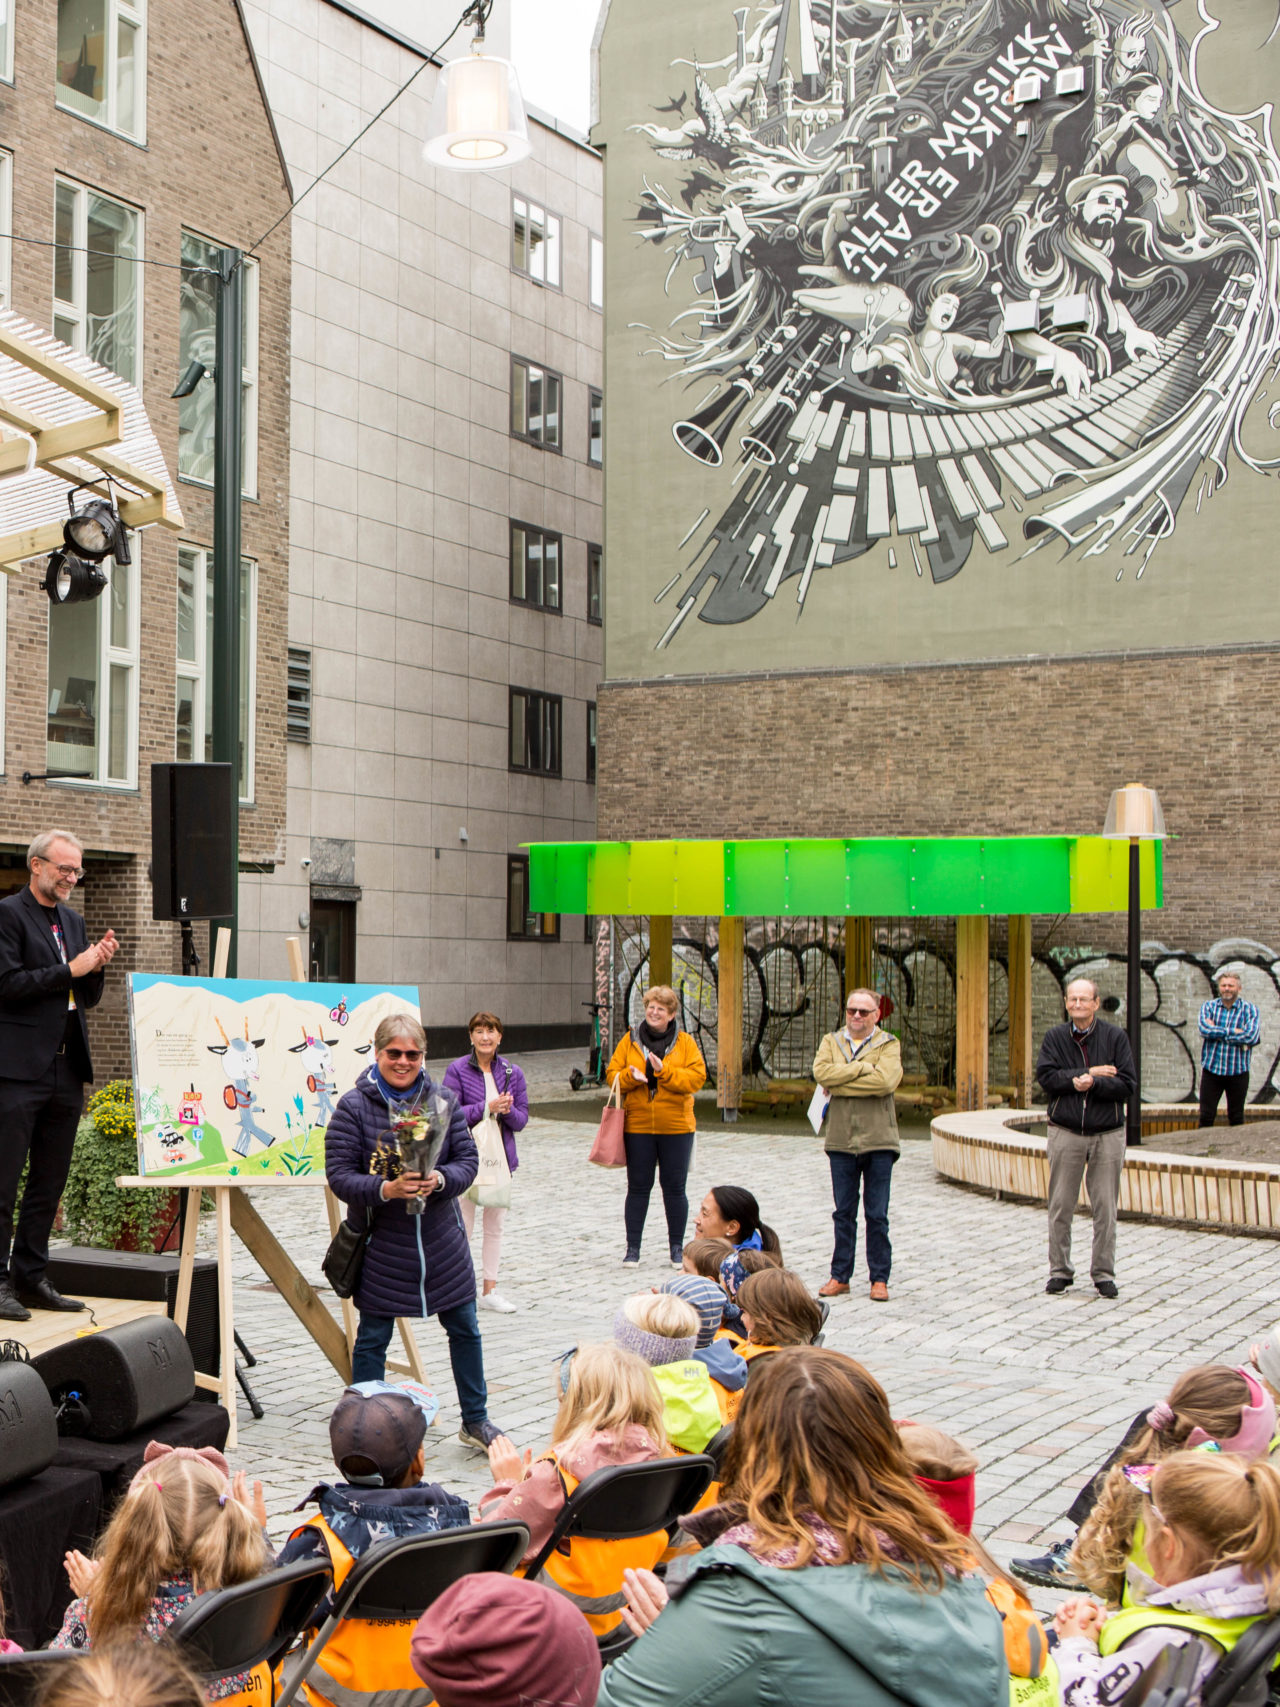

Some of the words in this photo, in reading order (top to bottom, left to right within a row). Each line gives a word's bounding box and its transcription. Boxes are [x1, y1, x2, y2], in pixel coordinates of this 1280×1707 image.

[838, 201, 890, 271] ALT
[884, 159, 932, 208] ER
[908, 166, 960, 219] ER
[683, 1367, 700, 1377] HH
